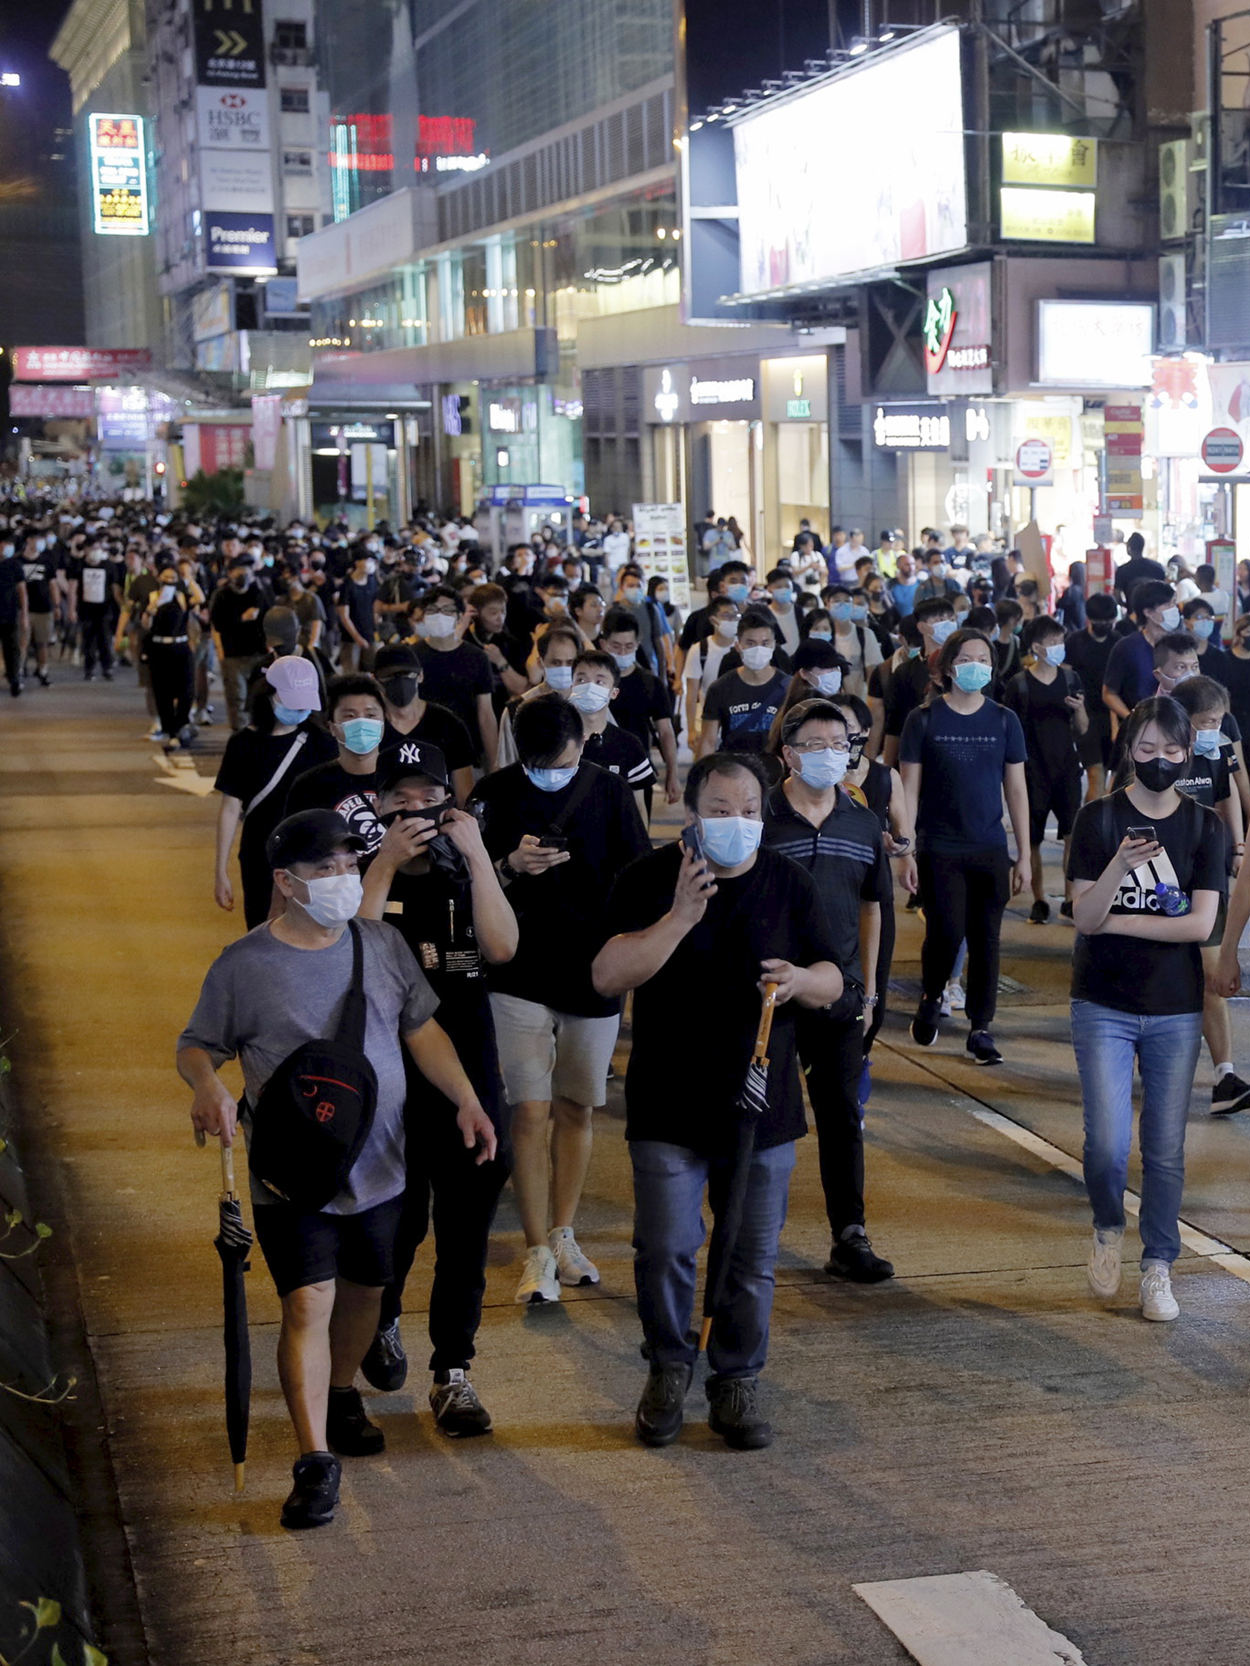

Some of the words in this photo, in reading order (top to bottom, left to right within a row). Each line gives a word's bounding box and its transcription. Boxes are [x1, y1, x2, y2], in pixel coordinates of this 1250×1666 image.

[208, 111, 259, 127] HSBC
[210, 226, 270, 244] Premier
[399, 743, 420, 764] NY
